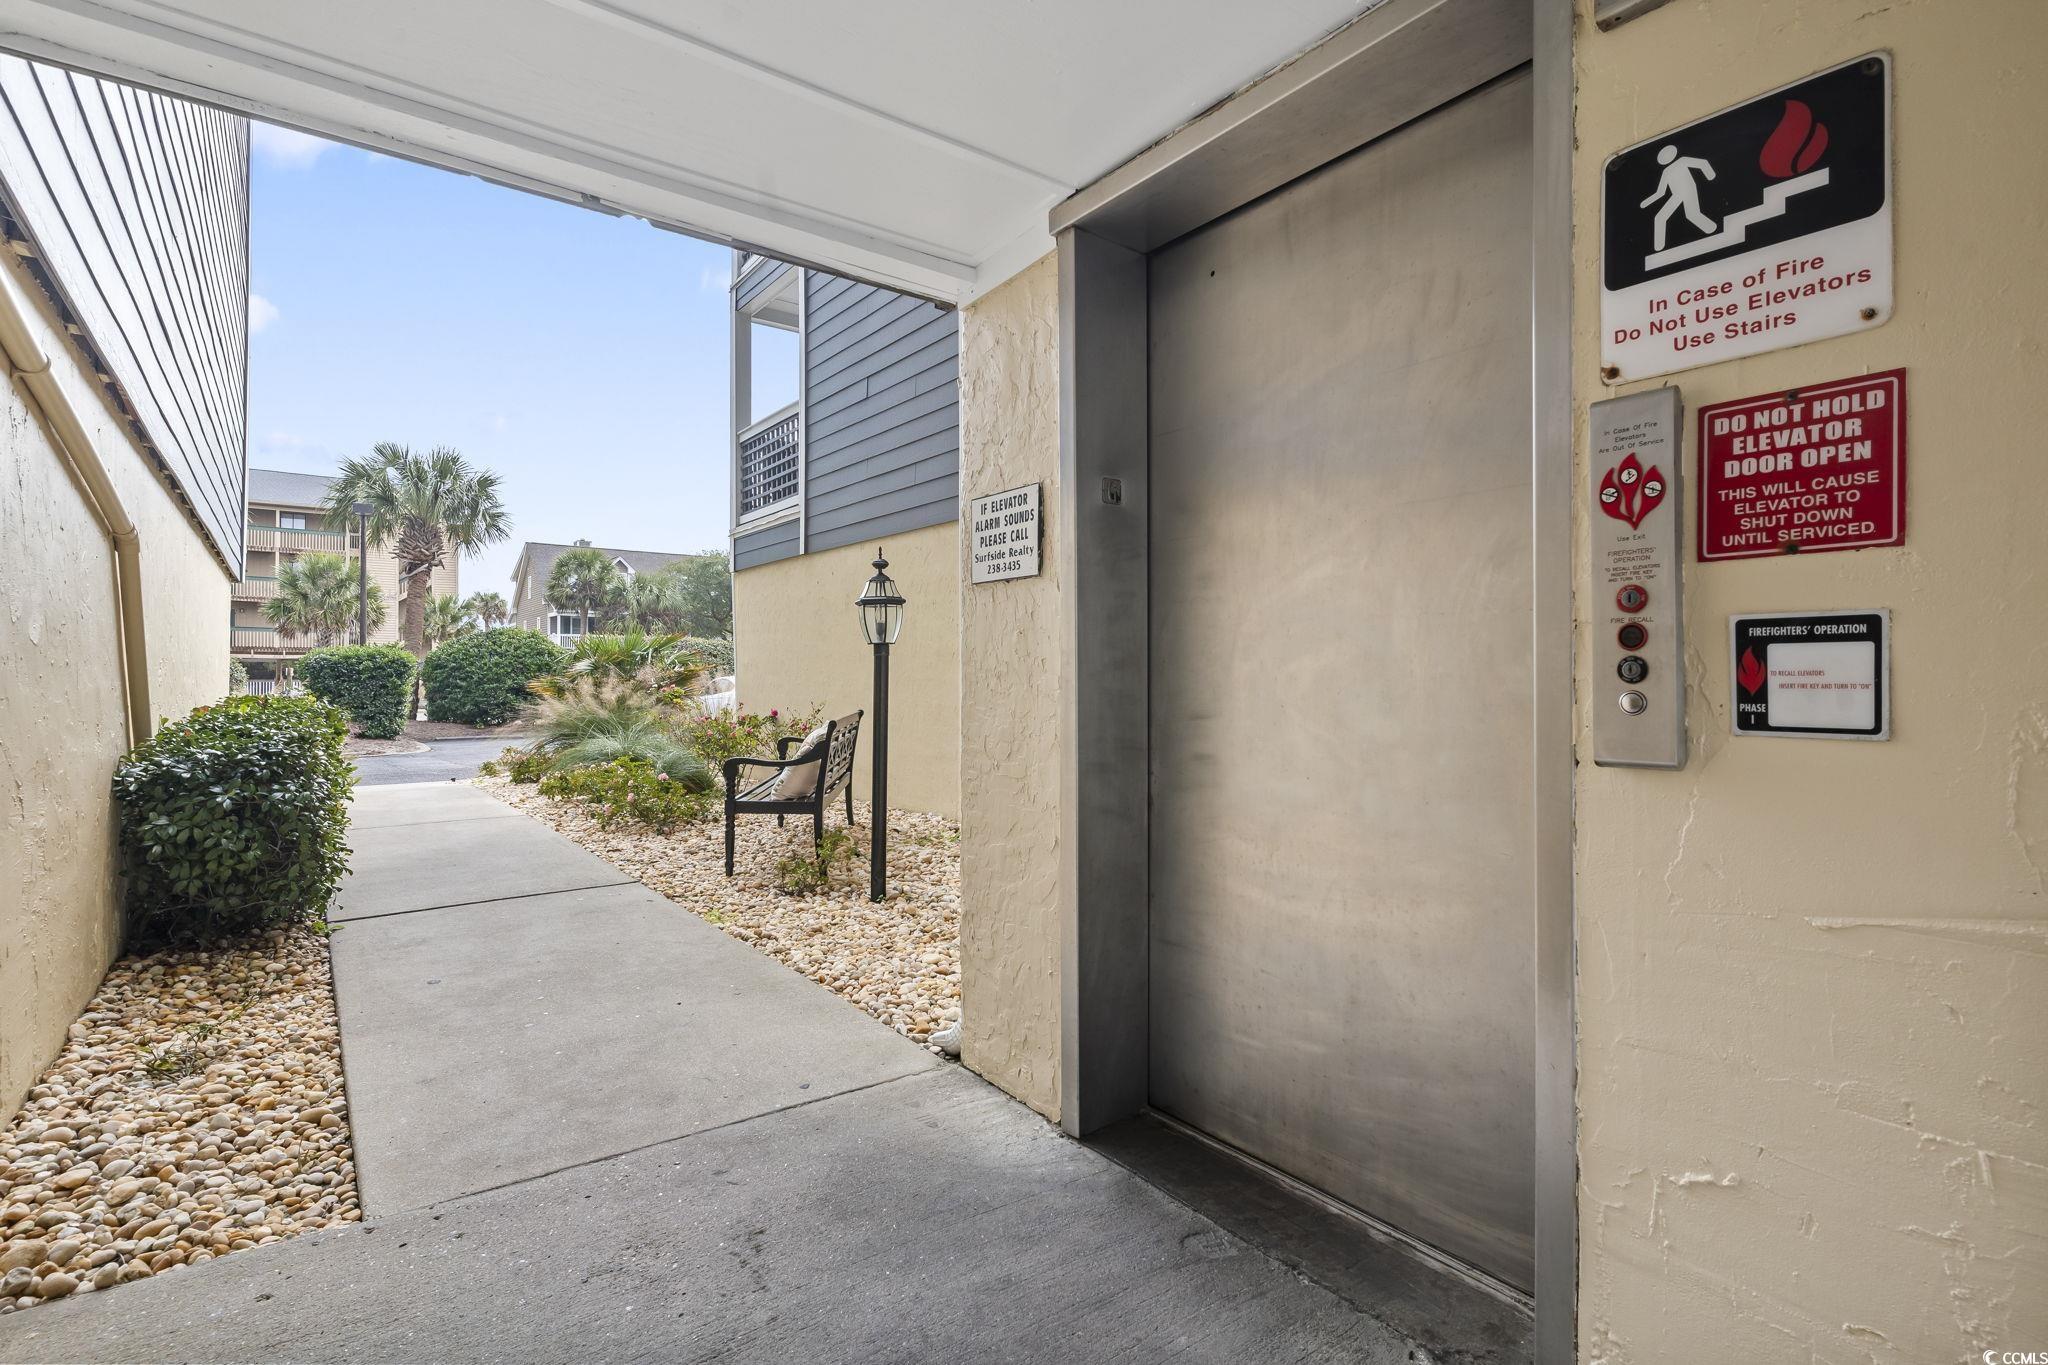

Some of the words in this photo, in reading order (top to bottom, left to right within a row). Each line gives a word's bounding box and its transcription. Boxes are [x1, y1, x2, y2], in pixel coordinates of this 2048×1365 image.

[1649, 298, 1668, 314] In
[1676, 281, 1733, 306] Case
[1742, 268, 1766, 288] of
[1776, 256, 1824, 280] Fire
[1614, 328, 1641, 344] Do
[1650, 314, 1686, 335] Not
[1695, 302, 1738, 324] Use
[1748, 268, 1872, 310] Elevators
[1673, 332, 1715, 351] Use
[1724, 312, 1797, 339] Stairs
[1714, 414, 1747, 436] DO
[1754, 403, 1806, 429] NOT
[1813, 389, 1885, 419] HOLD
[1615, 433, 1646, 442] Elevators
[1639, 438, 1664, 447] Service
[1733, 418, 1862, 455] ELEVATOR
[1724, 452, 1793, 478] DOOR
[1800, 440, 1872, 468] OPEN
[1718, 487, 1756, 502] THIS
[1762, 481, 1806, 495] WILL
[1812, 470, 1880, 490] CAUSE
[981, 503, 987, 515] IF
[991, 493, 1028, 513] ELEVATOR
[1734, 494, 1828, 515] ELEVATOR
[1834, 490, 1861, 504] TO
[975, 517, 1000, 532] ALARM
[1004, 509, 1034, 526] SOUNDS
[1740, 514, 1788, 530] SHUT
[1794, 507, 1853, 525] DOWN
[980, 532, 1007, 548] PLEASE
[1011, 527, 1028, 542] CALL
[1722, 532, 1772, 547] UNTIL
[975, 550, 1006, 563] Surfside
[1009, 545, 1034, 558] Realty
[1613, 555, 1651, 563] OPERATION
[987, 560, 1021, 574] 238-3435
[1814, 624, 1867, 635] OPERATION
[1739, 703, 1766, 712] PHASE
